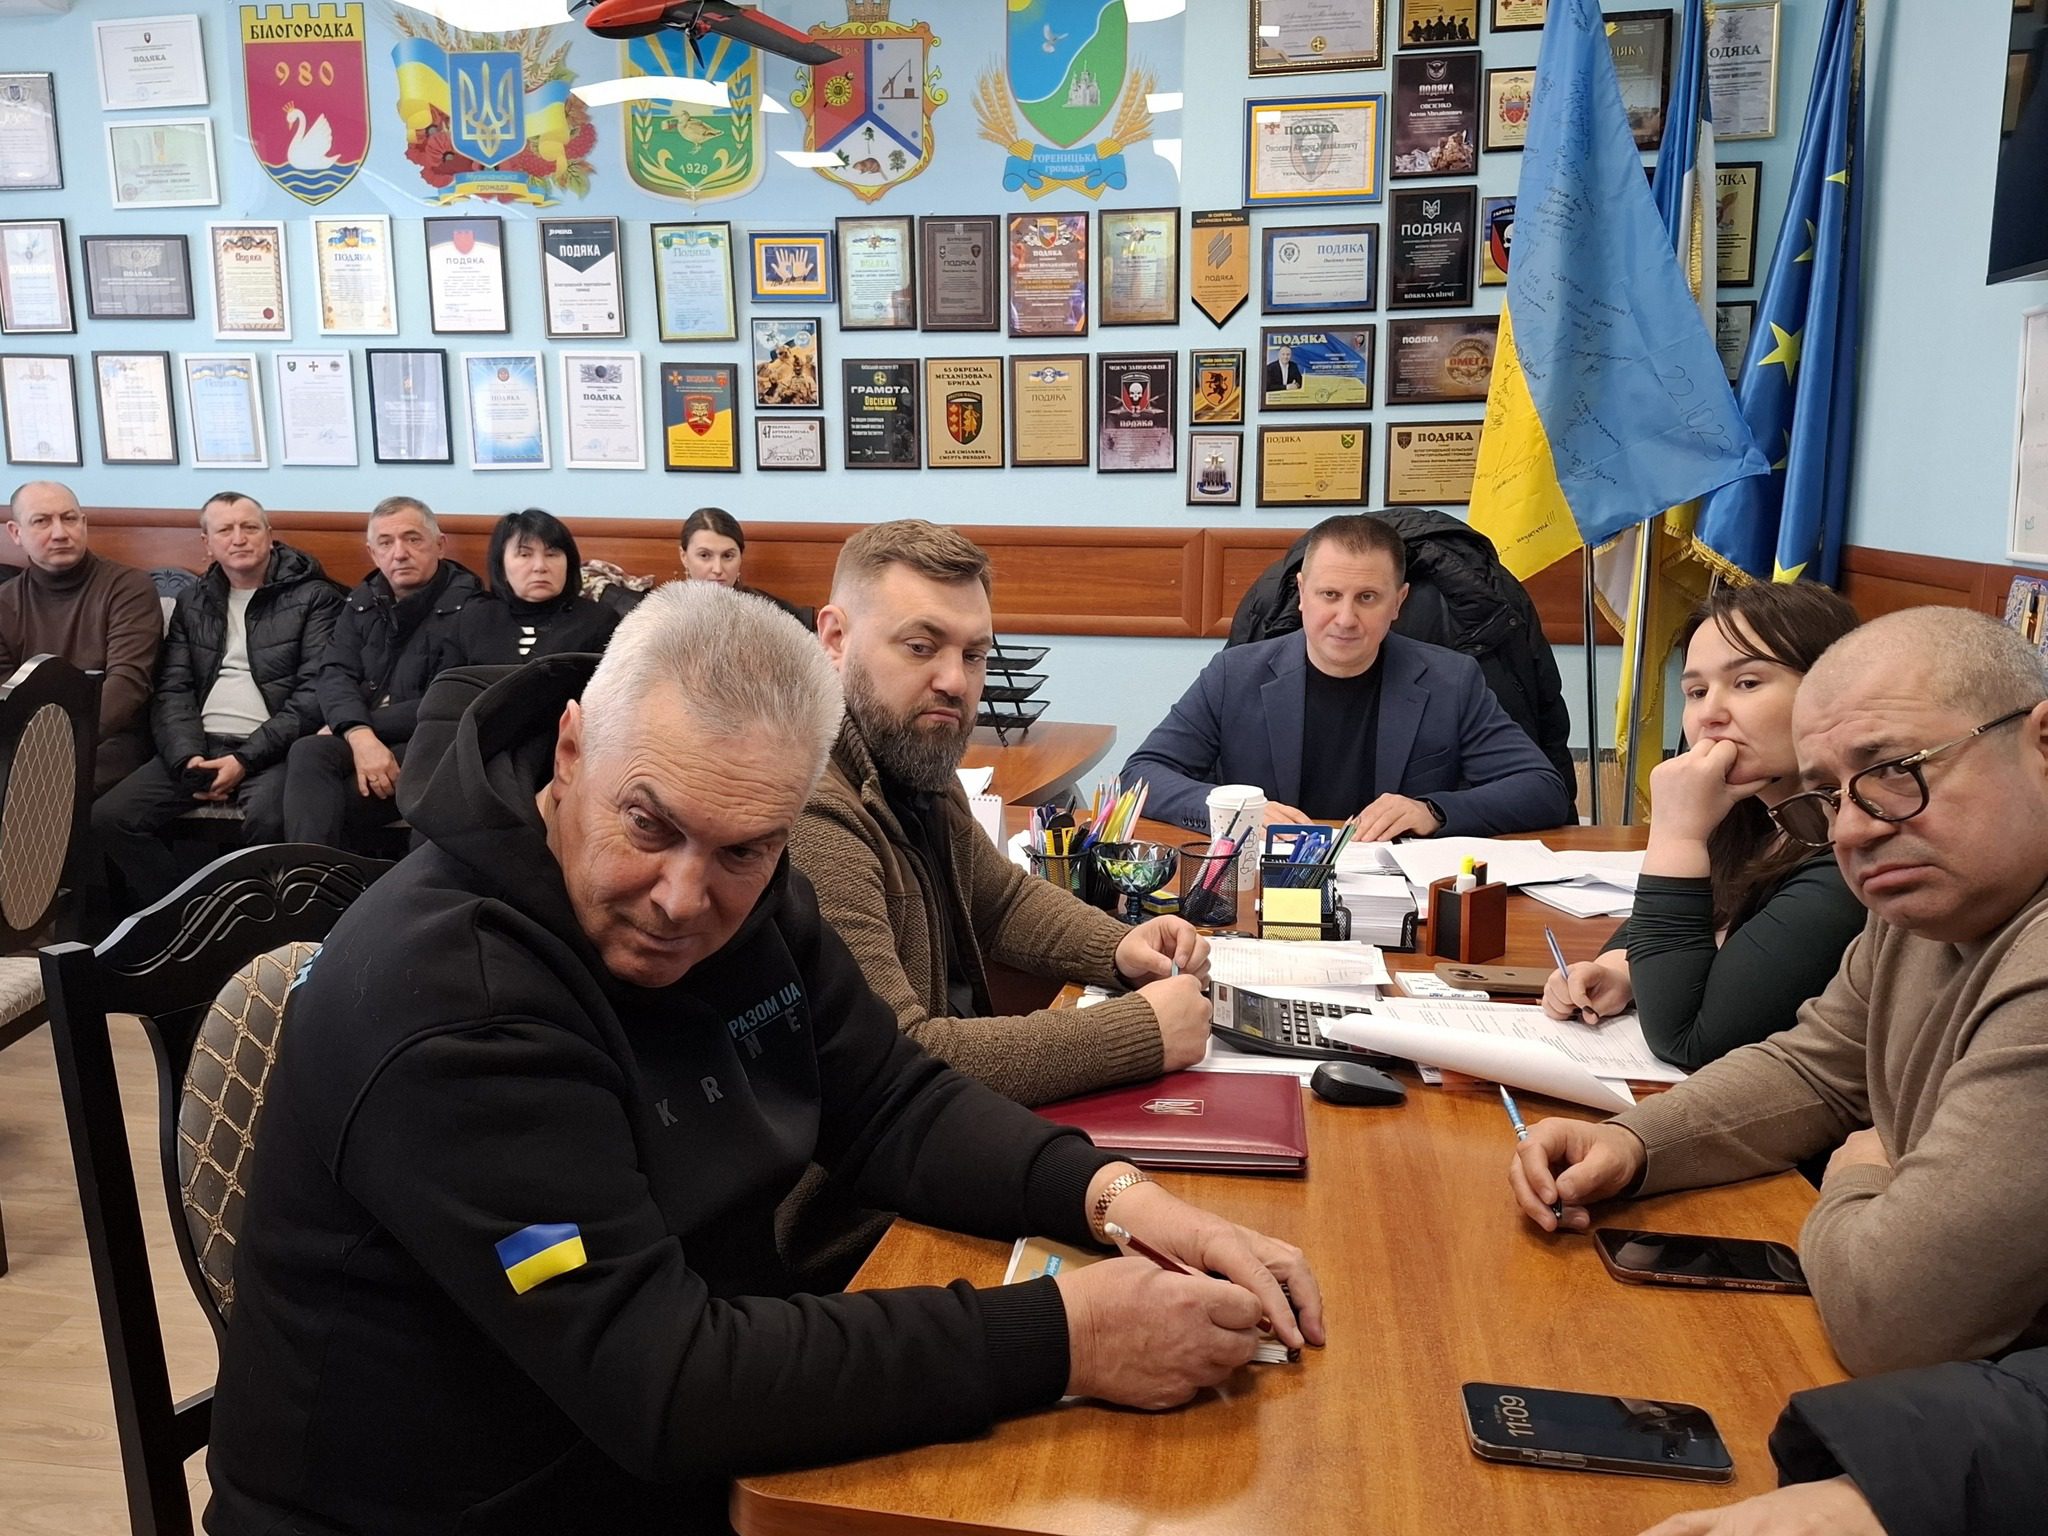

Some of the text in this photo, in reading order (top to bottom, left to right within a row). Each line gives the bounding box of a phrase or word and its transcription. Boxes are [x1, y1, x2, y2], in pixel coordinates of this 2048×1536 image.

[250, 23, 354, 39] БІЛОГОРОДКА
[133, 54, 166, 63] ПОДЯКА
[275, 61, 334, 86] 980
[1419, 83, 1454, 96] ПОДЯКА
[1284, 124, 1340, 135] ПОДЯКА
[1033, 153, 1098, 163] ГОРЕНИЦЬКА
[680, 163, 708, 175] 1928
[1045, 165, 1085, 175] громада
[476, 184, 509, 192] громада
[1401, 221, 1463, 237] ПОДЯКА
[560, 244, 601, 257] ПОДЯКА
[1317, 243, 1364, 254] ПОДЯКА
[334, 253, 372, 262] ПОДЯКА
[446, 257, 485, 265] ПОДЯКА
[1273, 333, 1328, 345] ПОДЯКА
[1402, 335, 1439, 344] ПОДЯКА
[1449, 357, 1489, 367] ОМЕГА
[851, 386, 909, 394] ГРАМОТА
[583, 393, 622, 402] ПОДЯКА
[1031, 394, 1067, 402] ПОДЯКА
[763, 425, 771, 439] 47
[1418, 432, 1474, 443] ПОДЯКА
[1266, 436, 1301, 444] ПОДЯКА
[779, 982, 802, 1006] UA
[1498, 1395, 1535, 1437] 11:09
